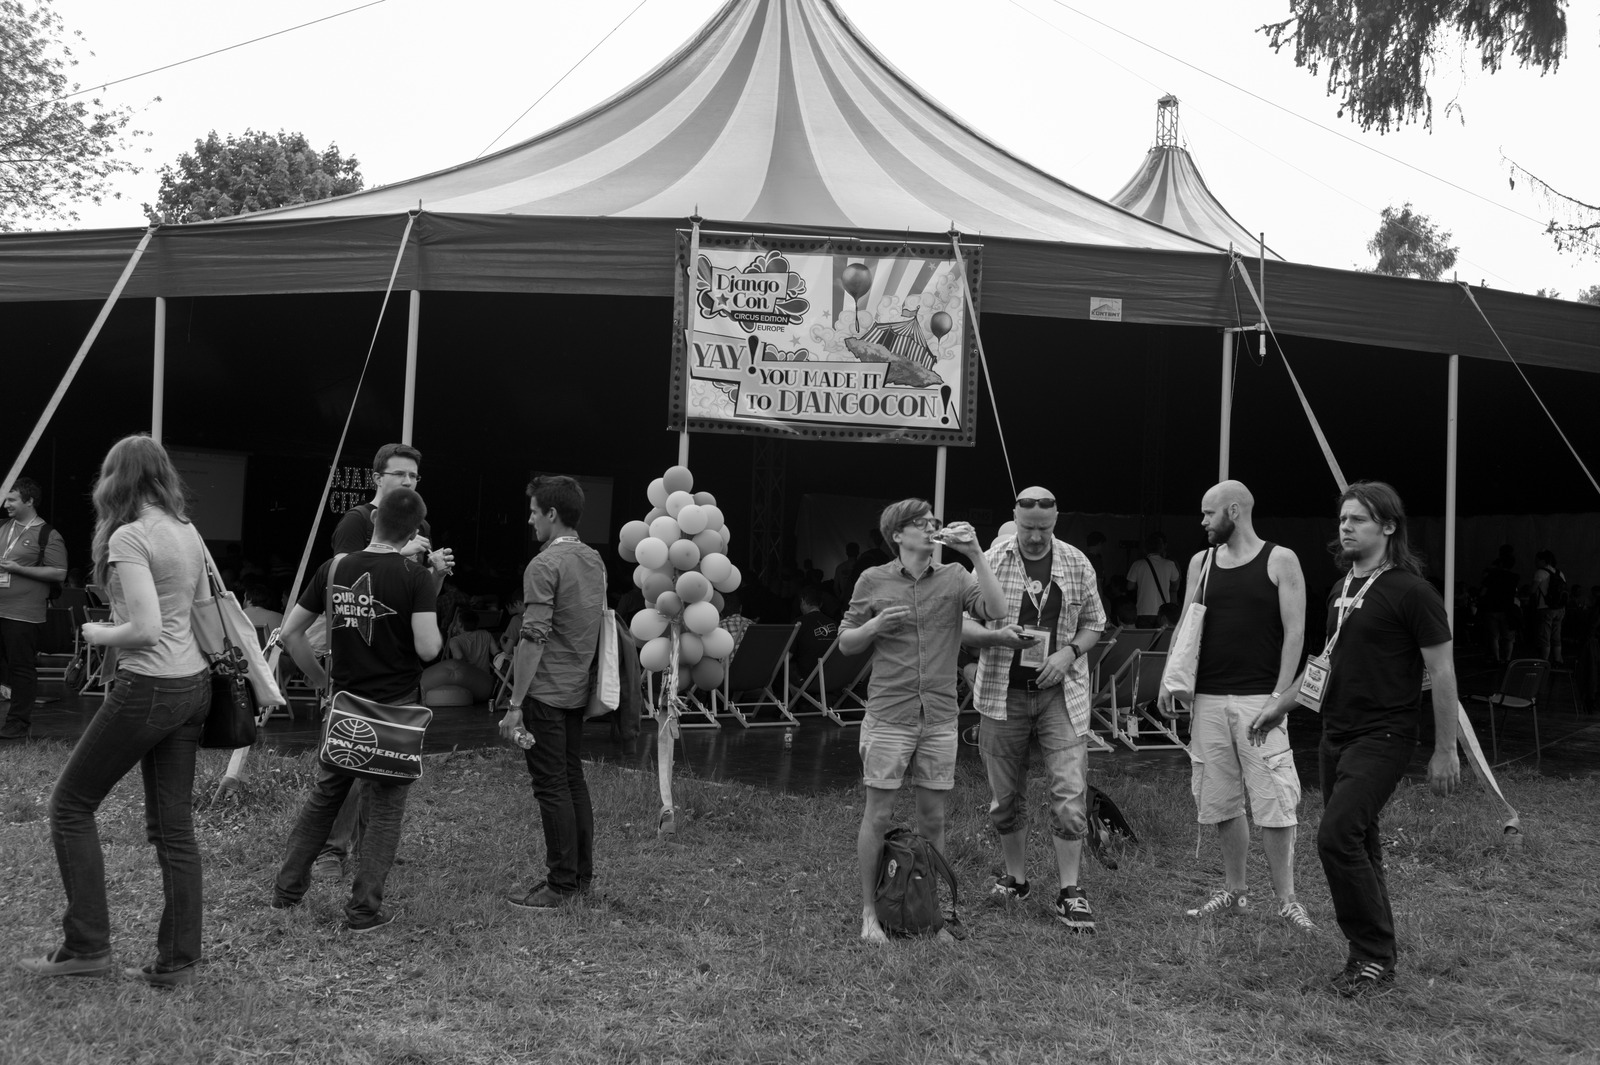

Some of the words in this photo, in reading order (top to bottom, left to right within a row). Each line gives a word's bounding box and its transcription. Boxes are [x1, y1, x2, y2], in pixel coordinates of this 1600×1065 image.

[716, 274, 780, 296] Django
[732, 292, 770, 310] Con
[734, 312, 760, 321] CIRCUS
[760, 314, 788, 323] EDITION
[757, 324, 785, 333] EUROPE
[693, 335, 759, 375] YAY!
[759, 368, 798, 386] YOU
[802, 370, 857, 389] MADE
[862, 373, 882, 390] IT
[746, 394, 772, 411] TO
[777, 385, 952, 425] DJANGOCON!
[332, 592, 355, 604] OUR
[333, 604, 376, 619] MERICA
[327, 737, 354, 749] PAN
